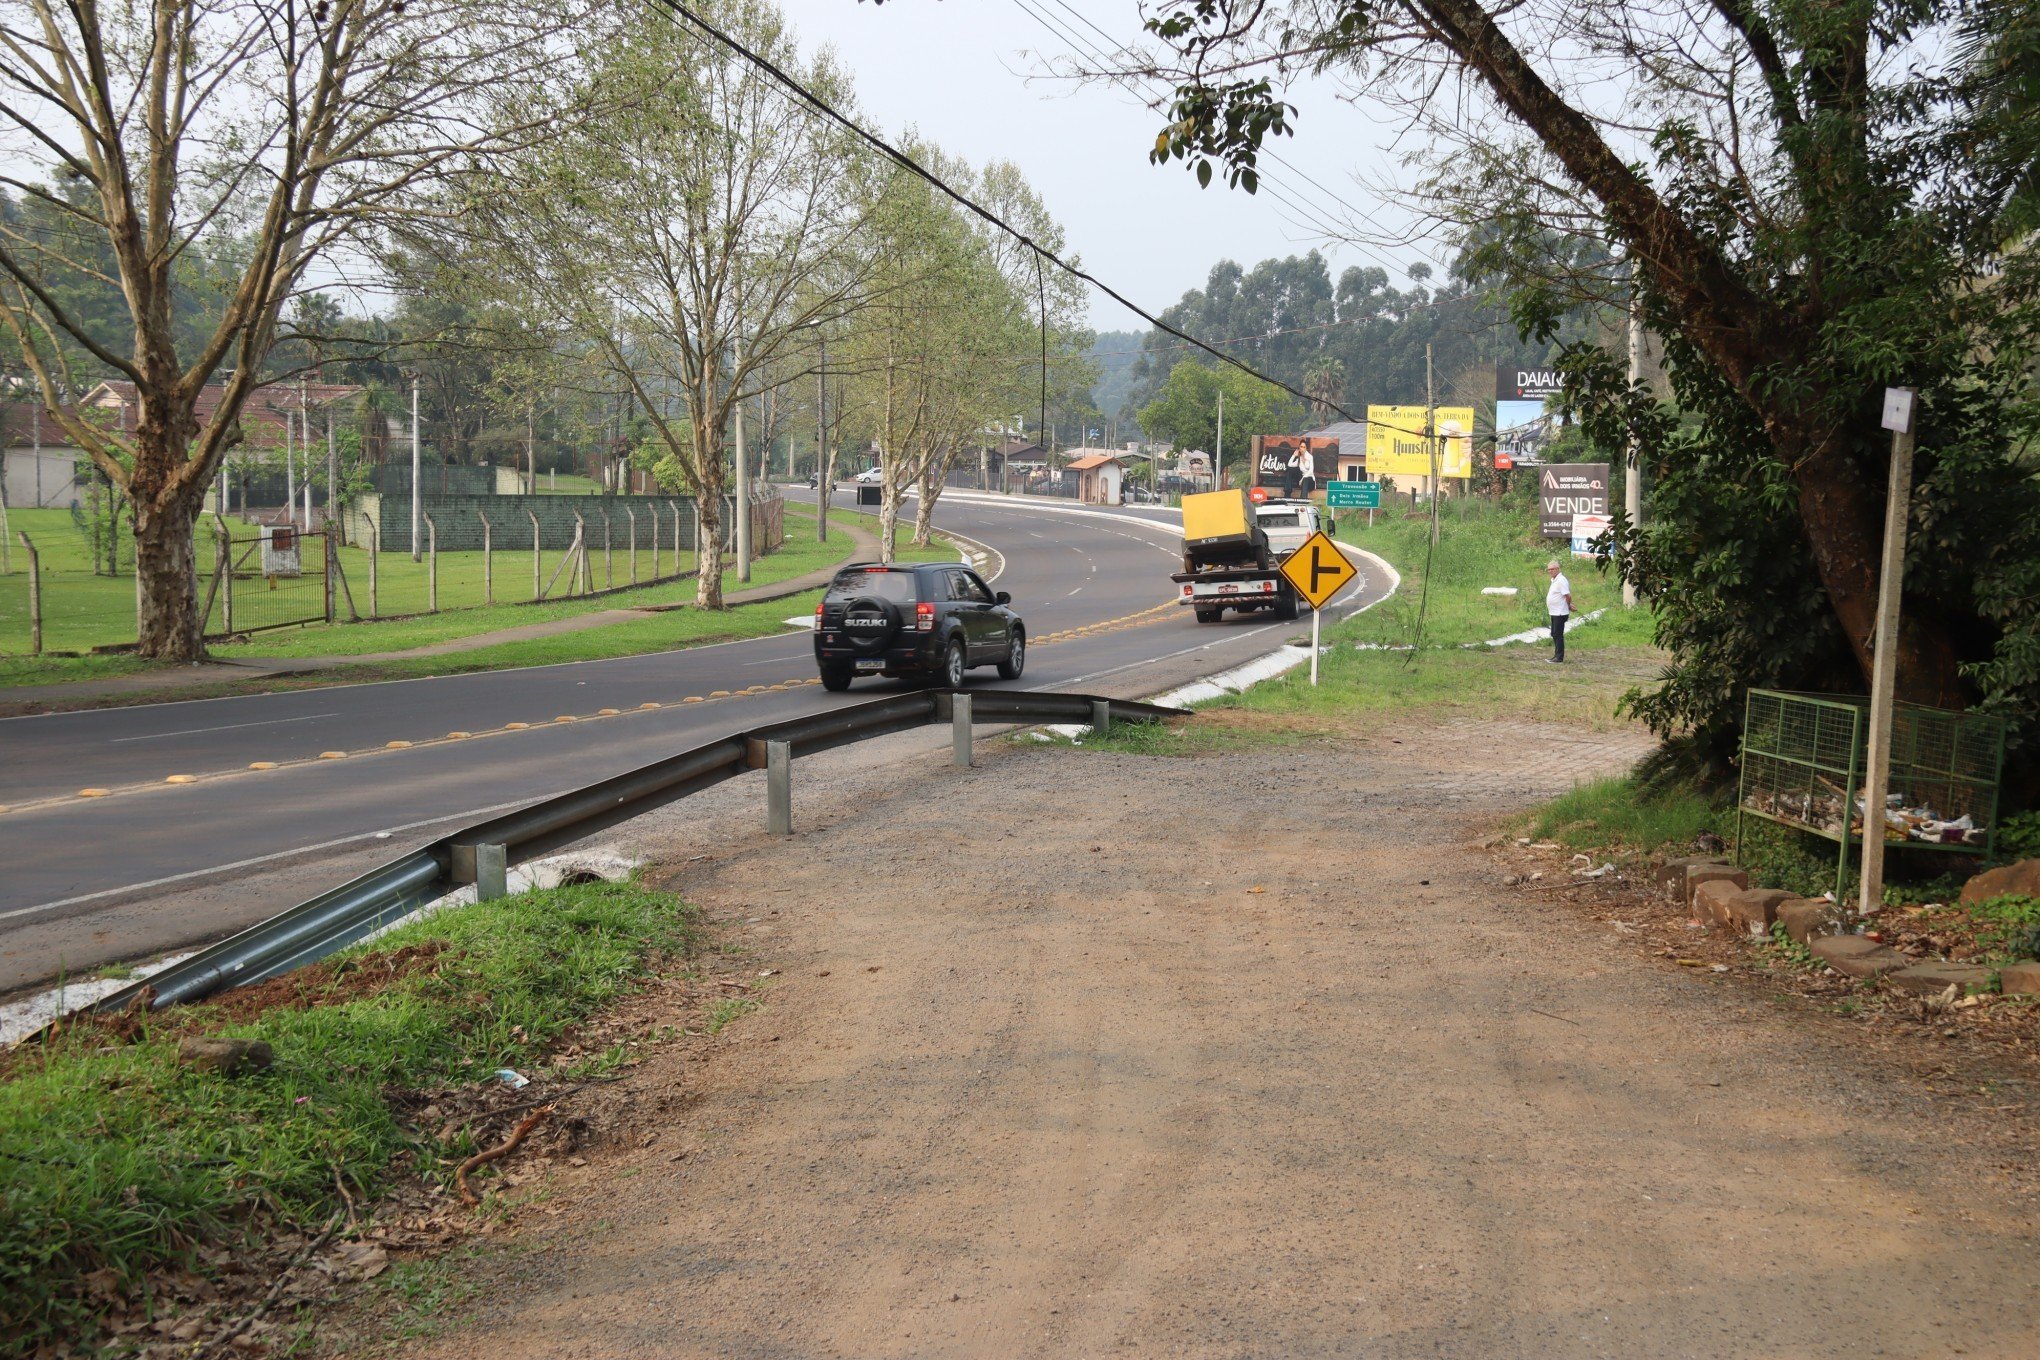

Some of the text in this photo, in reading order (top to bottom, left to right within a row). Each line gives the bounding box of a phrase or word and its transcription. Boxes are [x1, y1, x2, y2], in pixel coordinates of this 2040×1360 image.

[1517, 371, 1566, 387] DAIAN
[1590, 480, 1601, 489] 40
[1544, 497, 1603, 514] VENDE
[844, 619, 887, 627] SUZUKI
